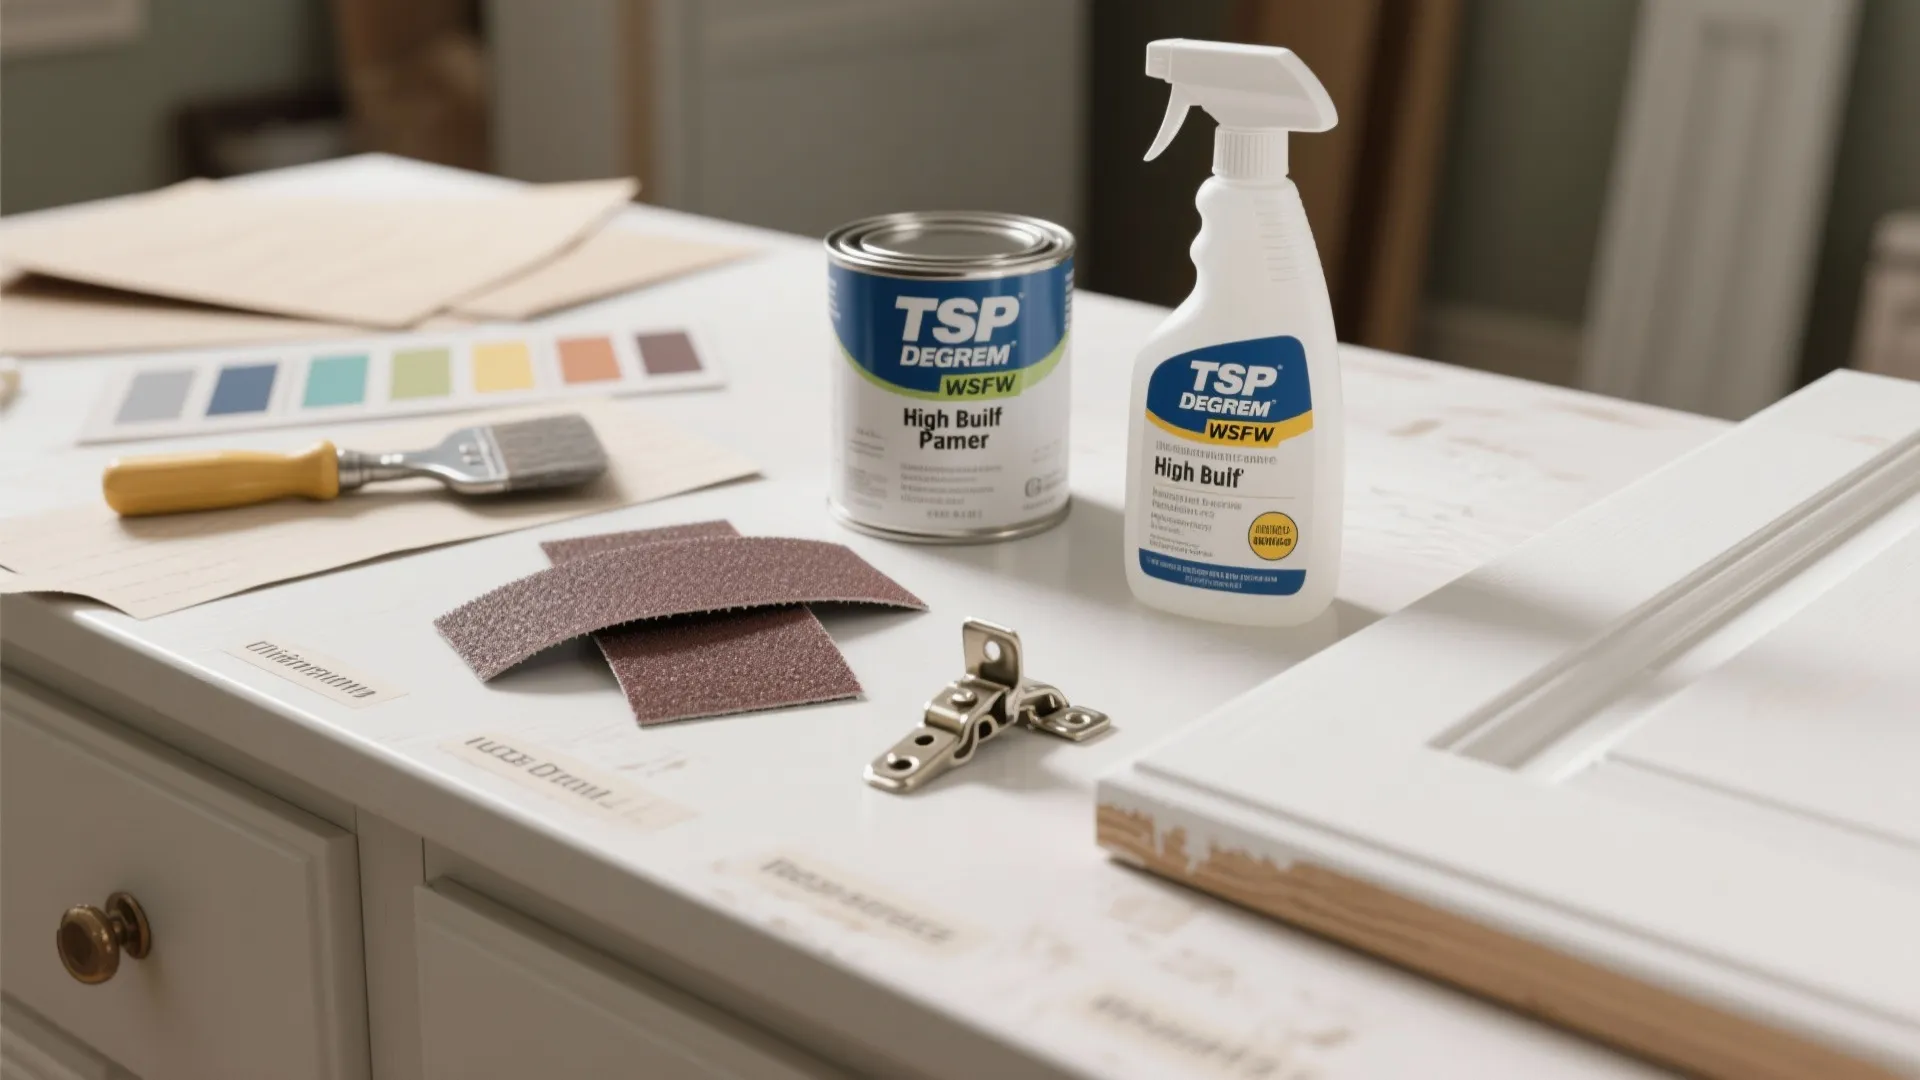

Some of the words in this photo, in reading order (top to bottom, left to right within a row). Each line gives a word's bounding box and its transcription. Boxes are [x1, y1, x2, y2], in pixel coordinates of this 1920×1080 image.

[895, 296, 1020, 343] TSP
[900, 344, 1011, 367] DEGREM
[946, 374, 1016, 396] WSFW
[1190, 360, 1278, 396] TSP
[1179, 392, 1271, 417] DEGREM
[904, 407, 949, 431] High
[1209, 423, 1275, 442] WSFW
[1155, 456, 1194, 482] High
